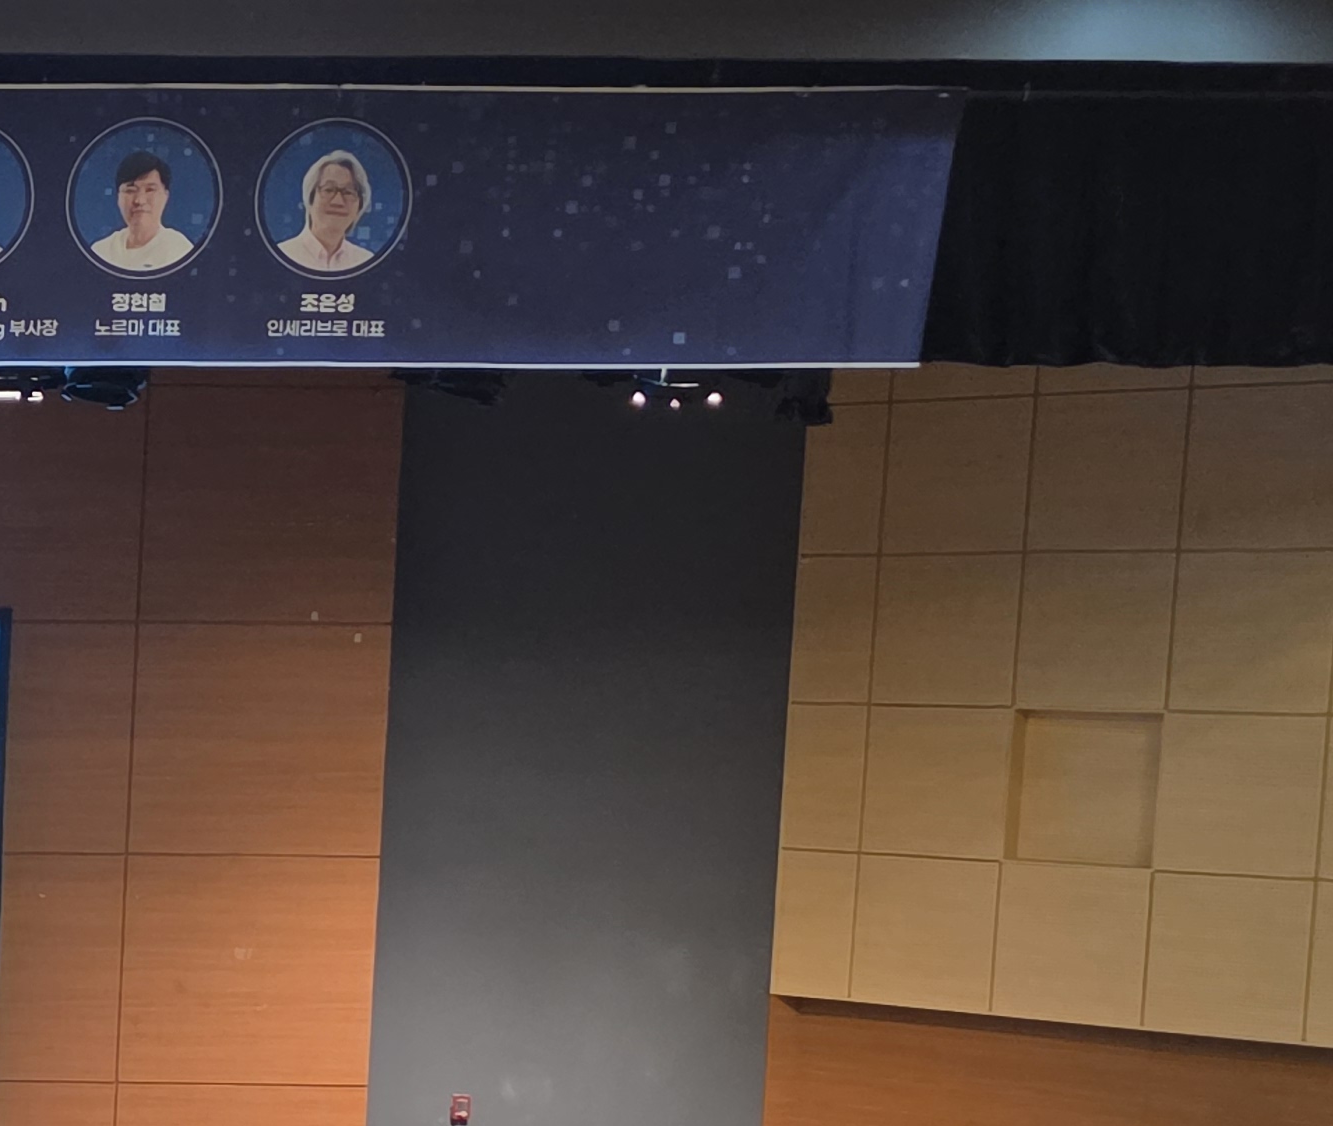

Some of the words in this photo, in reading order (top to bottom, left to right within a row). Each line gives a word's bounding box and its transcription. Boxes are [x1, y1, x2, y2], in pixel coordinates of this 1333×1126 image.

[299, 293, 355, 313] 조은성
[9, 319, 59, 338] 부사장
[94, 318, 145, 338] 노르마
[147, 318, 181, 338] 대표
[266, 319, 349, 338] 인세리브로
[351, 319, 386, 338] 대표
